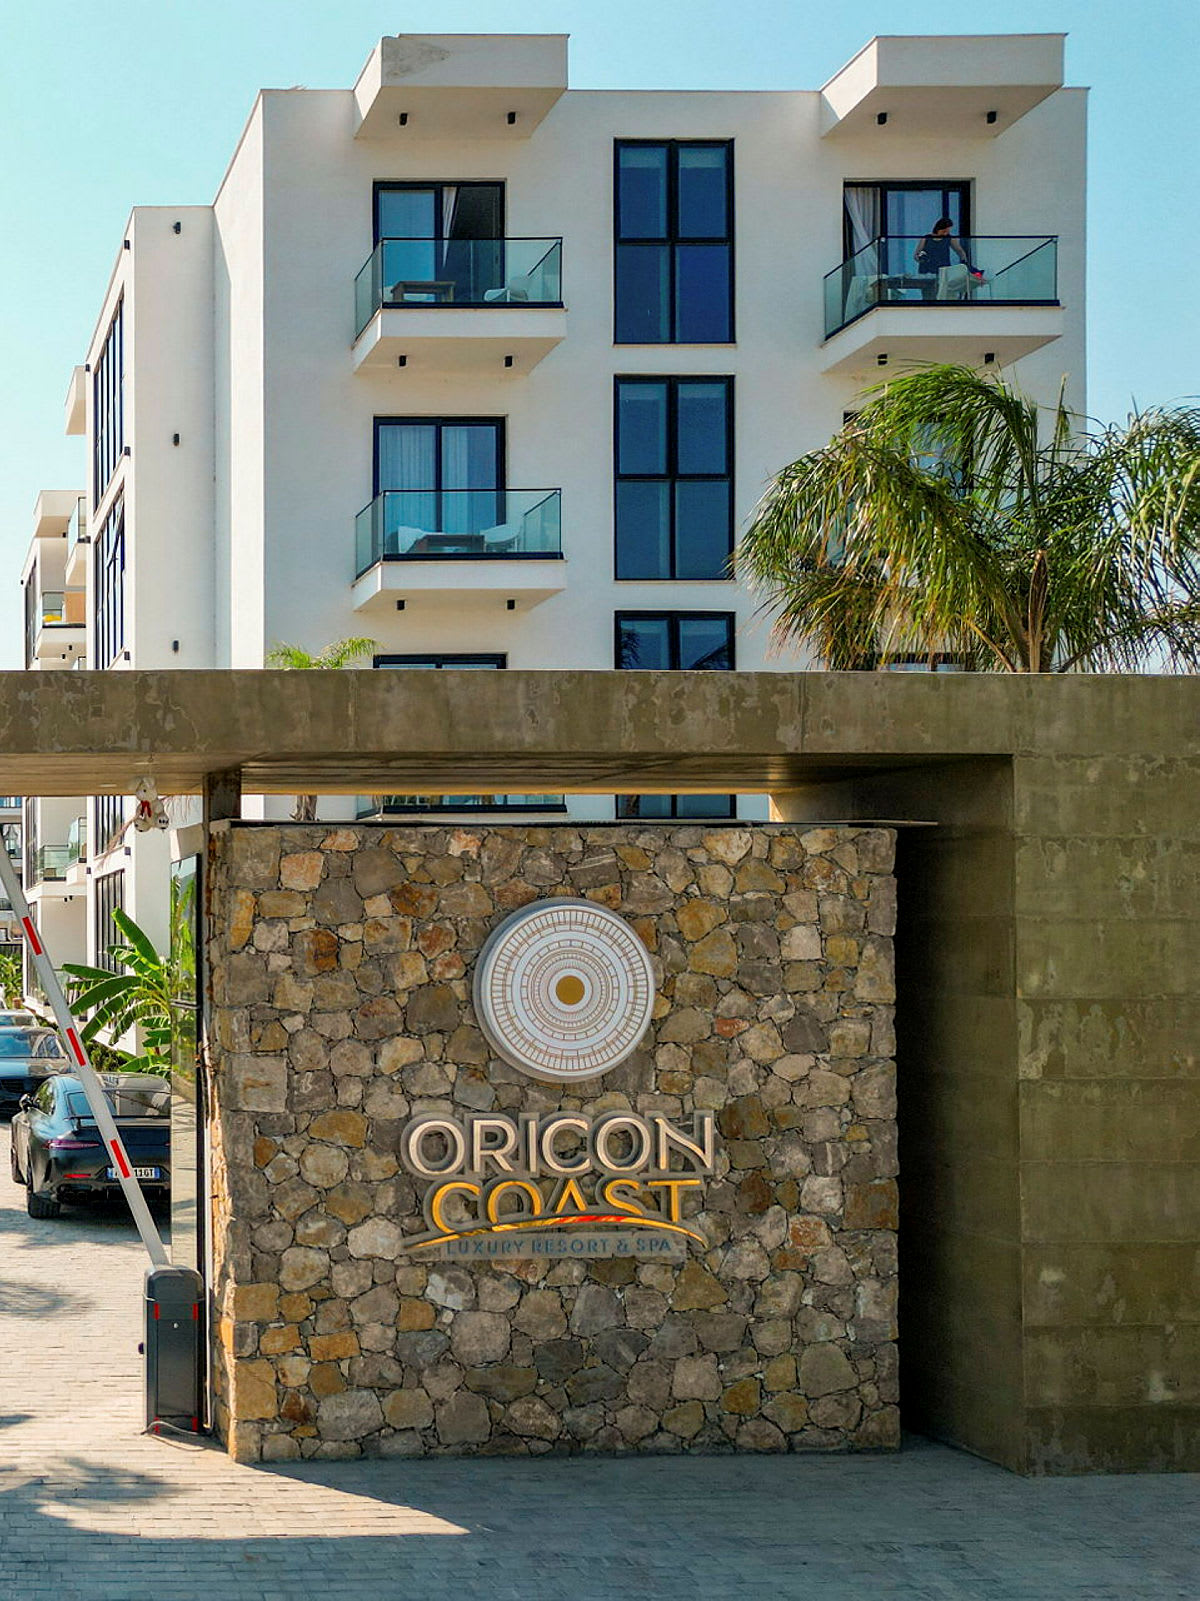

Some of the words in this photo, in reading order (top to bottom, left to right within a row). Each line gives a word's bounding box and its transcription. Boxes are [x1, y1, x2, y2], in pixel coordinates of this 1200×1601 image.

[407, 1116, 715, 1175] ORICON
[431, 1178, 701, 1234] COAST
[446, 1238, 525, 1255] LUXURY
[531, 1238, 608, 1254] RESORT
[615, 1238, 629, 1252] &
[636, 1237, 673, 1252] SPA
